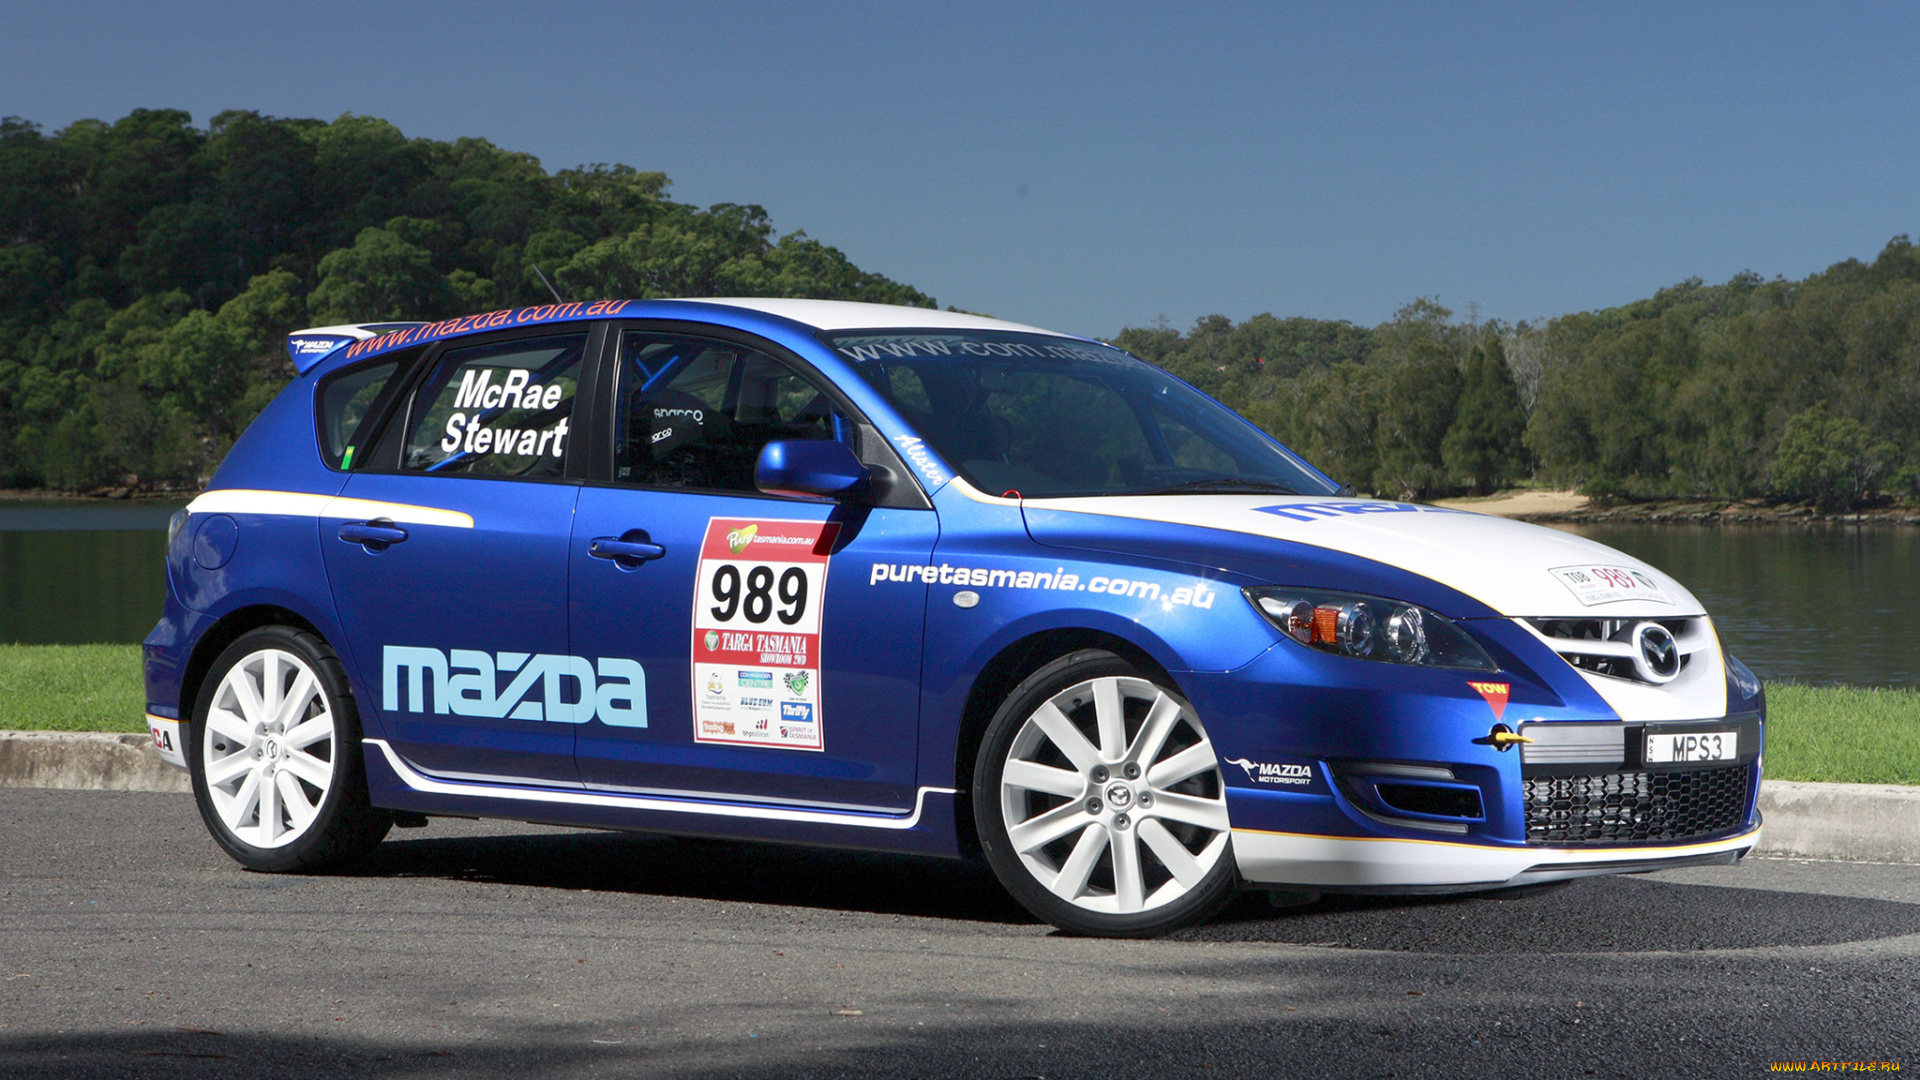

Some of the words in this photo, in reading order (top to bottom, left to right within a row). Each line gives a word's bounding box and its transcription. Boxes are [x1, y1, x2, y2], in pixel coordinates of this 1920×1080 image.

[345, 300, 630, 359] www.mazda.com.au
[453, 369, 562, 410] McRae
[441, 412, 568, 457] Stewart
[894, 434, 943, 486] Alister
[869, 562, 1216, 610] puretasmania.com.au
[1592, 568, 1636, 588] 989
[710, 564, 808, 625] 989
[721, 633, 753, 652] TARGA
[756, 634, 807, 654] TASMANIA
[760, 653, 792, 665] SHOWROOM
[793, 655, 807, 666] 2WD
[383, 645, 649, 729] mazda
[1472, 683, 1507, 694] TOW
[782, 704, 811, 720] Thrifty
[1672, 734, 1723, 762] MPS3
[1258, 763, 1312, 778] MAZDA
[1258, 776, 1312, 785] MOTORSPORT
